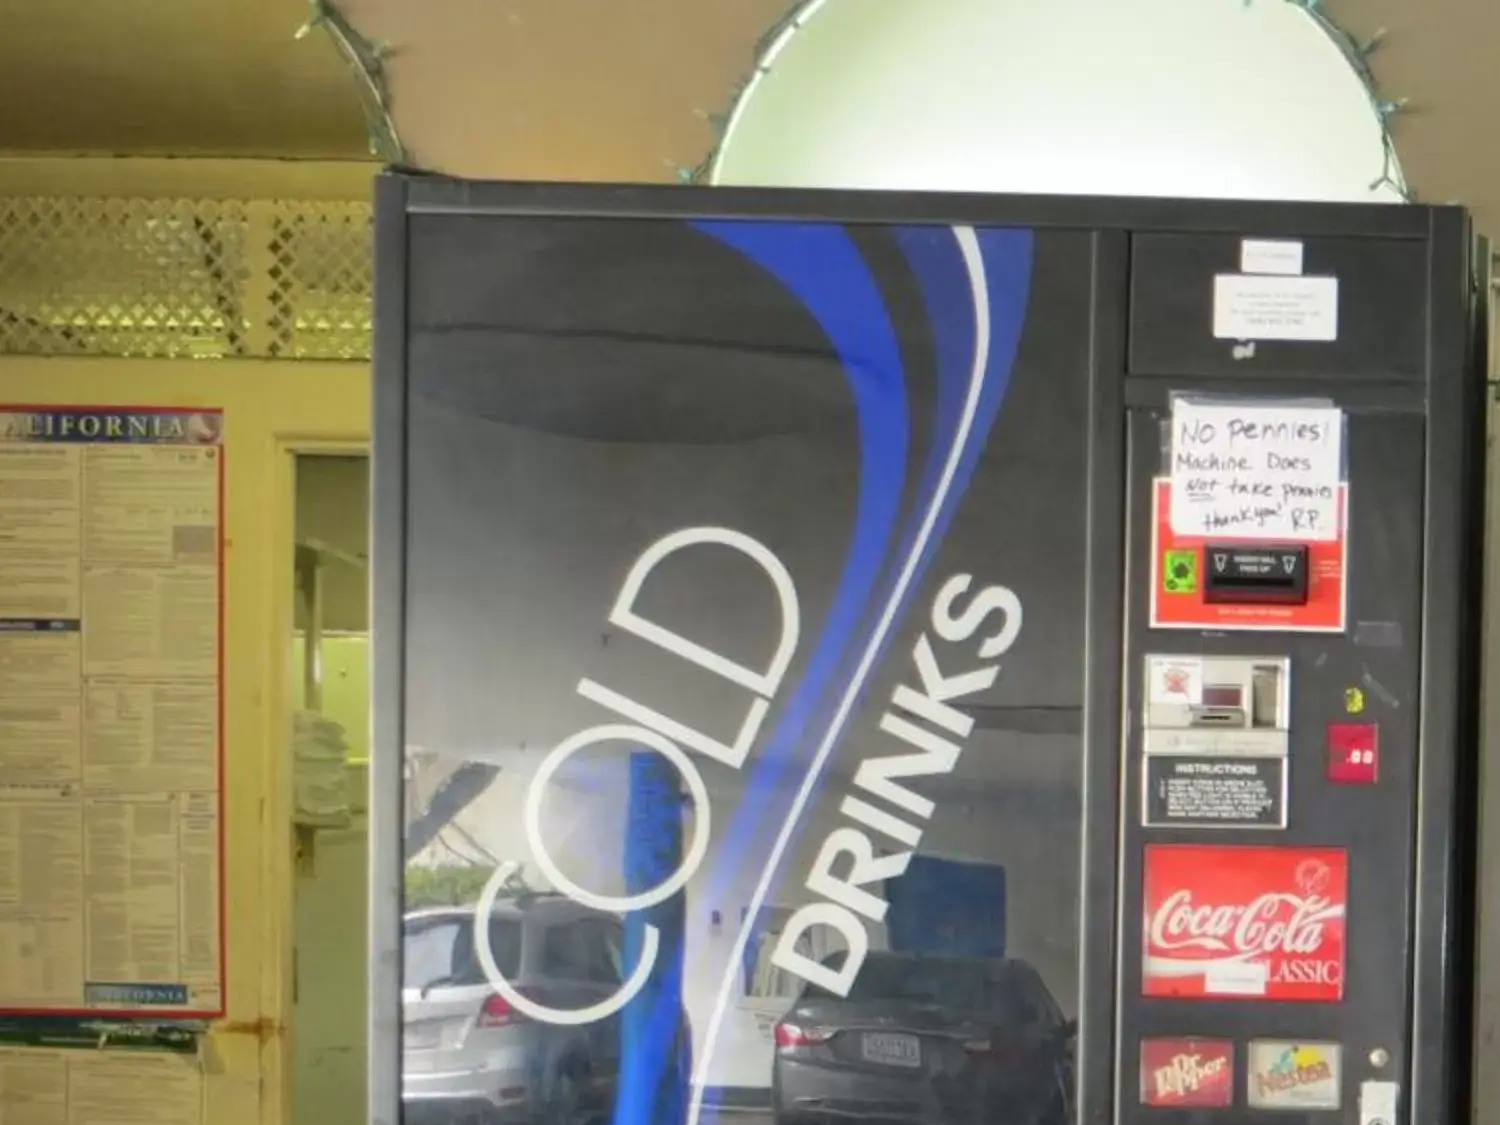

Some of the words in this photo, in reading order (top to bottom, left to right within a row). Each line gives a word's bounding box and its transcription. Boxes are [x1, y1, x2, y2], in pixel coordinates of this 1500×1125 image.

[1175, 451, 1253, 472] Machine
[1226, 480, 1274, 497] take
[474, 526, 800, 1025] COLD
[1174, 763, 1258, 775] INSTRUCTIONS
[771, 573, 1023, 998] DRINKS
[1266, 958, 1341, 986] LASSIC
